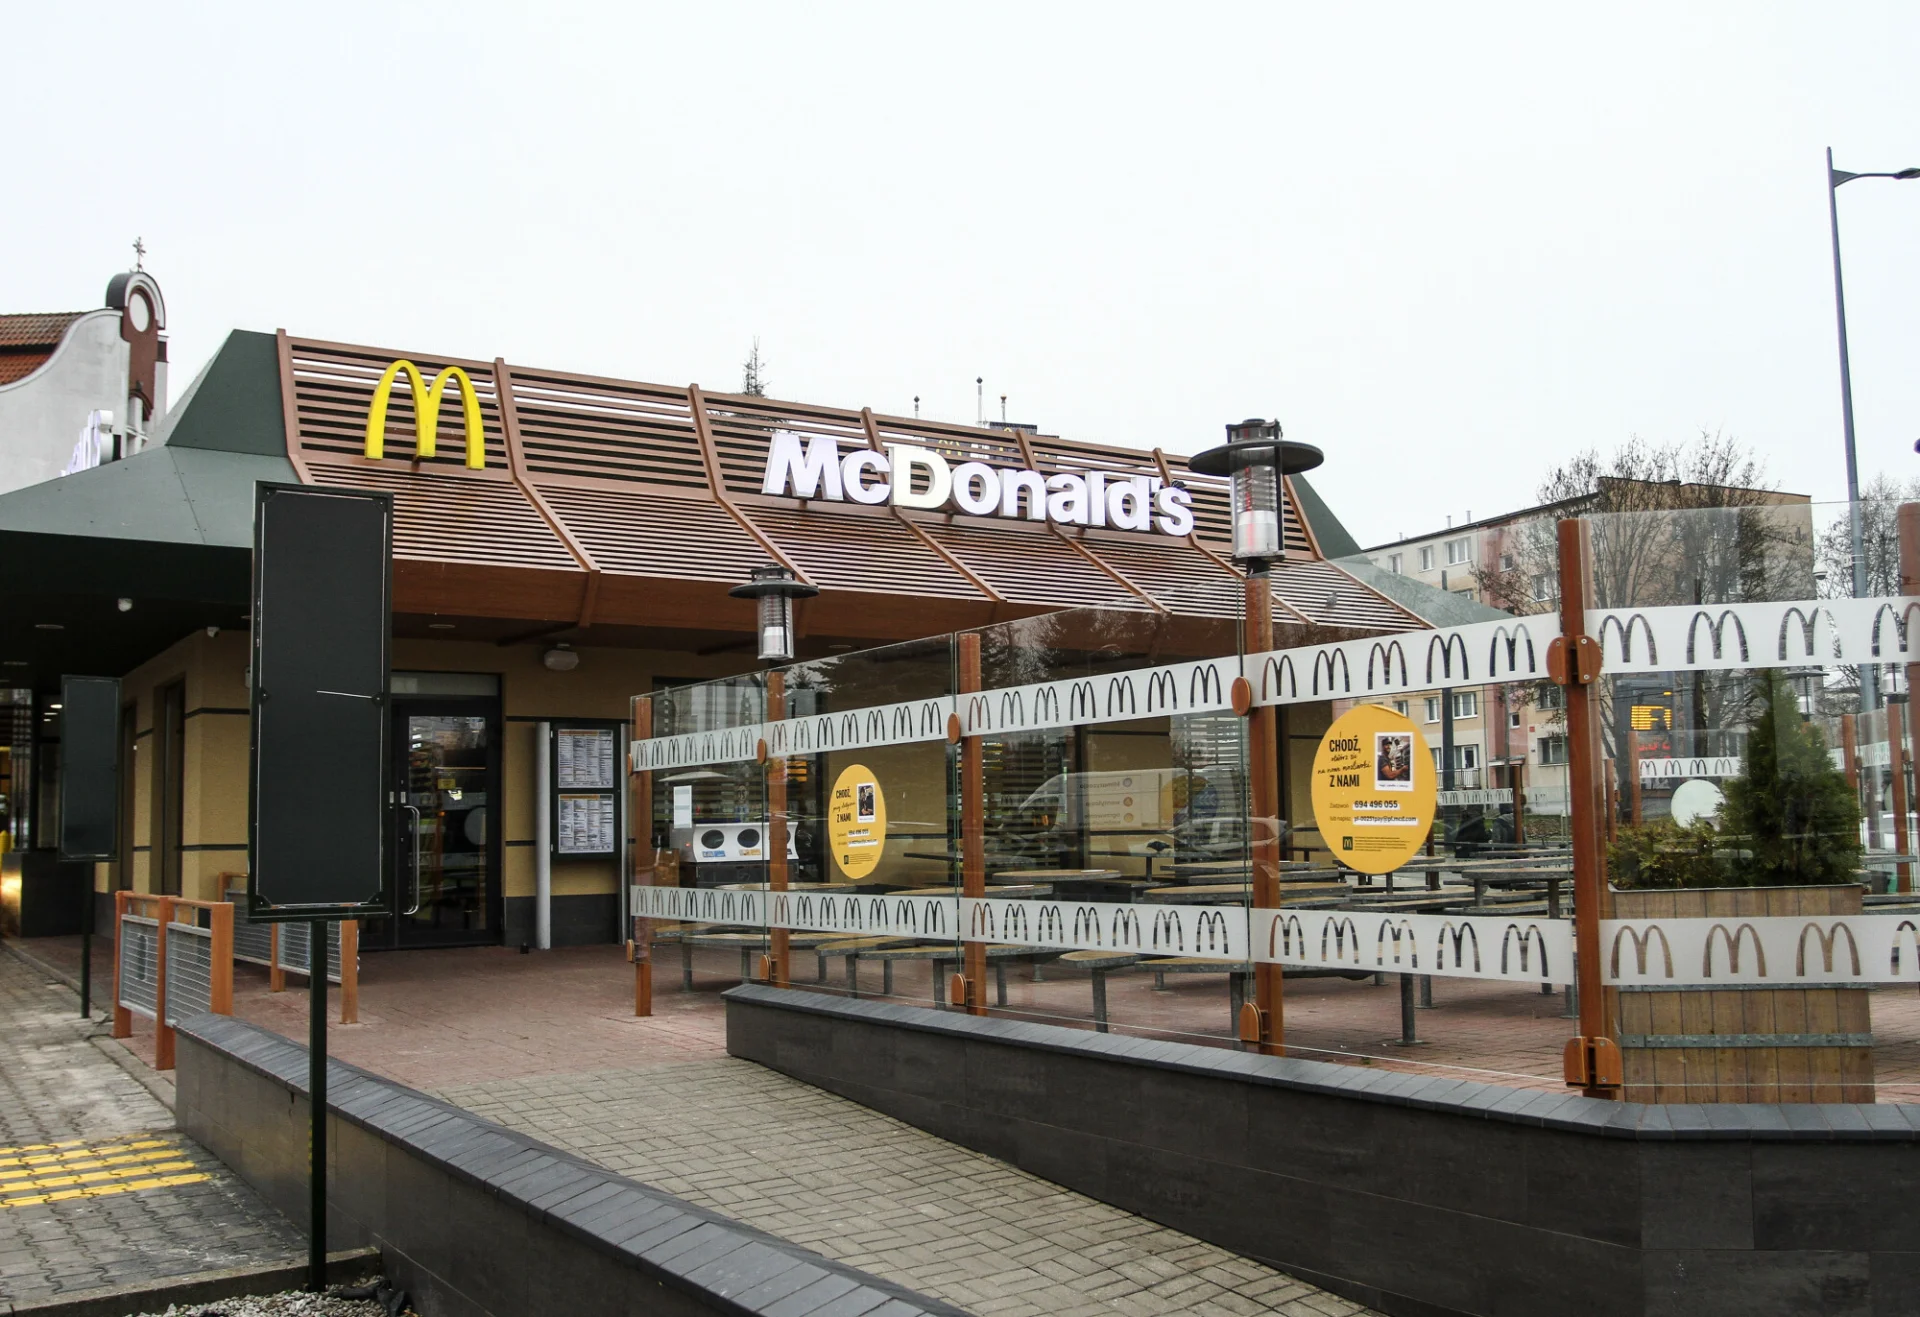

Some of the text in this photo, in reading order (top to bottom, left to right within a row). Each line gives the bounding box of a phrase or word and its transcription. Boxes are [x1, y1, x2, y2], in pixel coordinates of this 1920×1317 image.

[762, 432, 1195, 537] McDonald's
[1329, 735, 1361, 753] CHODŹ,
[1329, 774, 1360, 787] Z NAMI
[1354, 800, 1368, 809] 694
[1369, 800, 1383, 809] 496
[1383, 800, 1398, 809] 055
